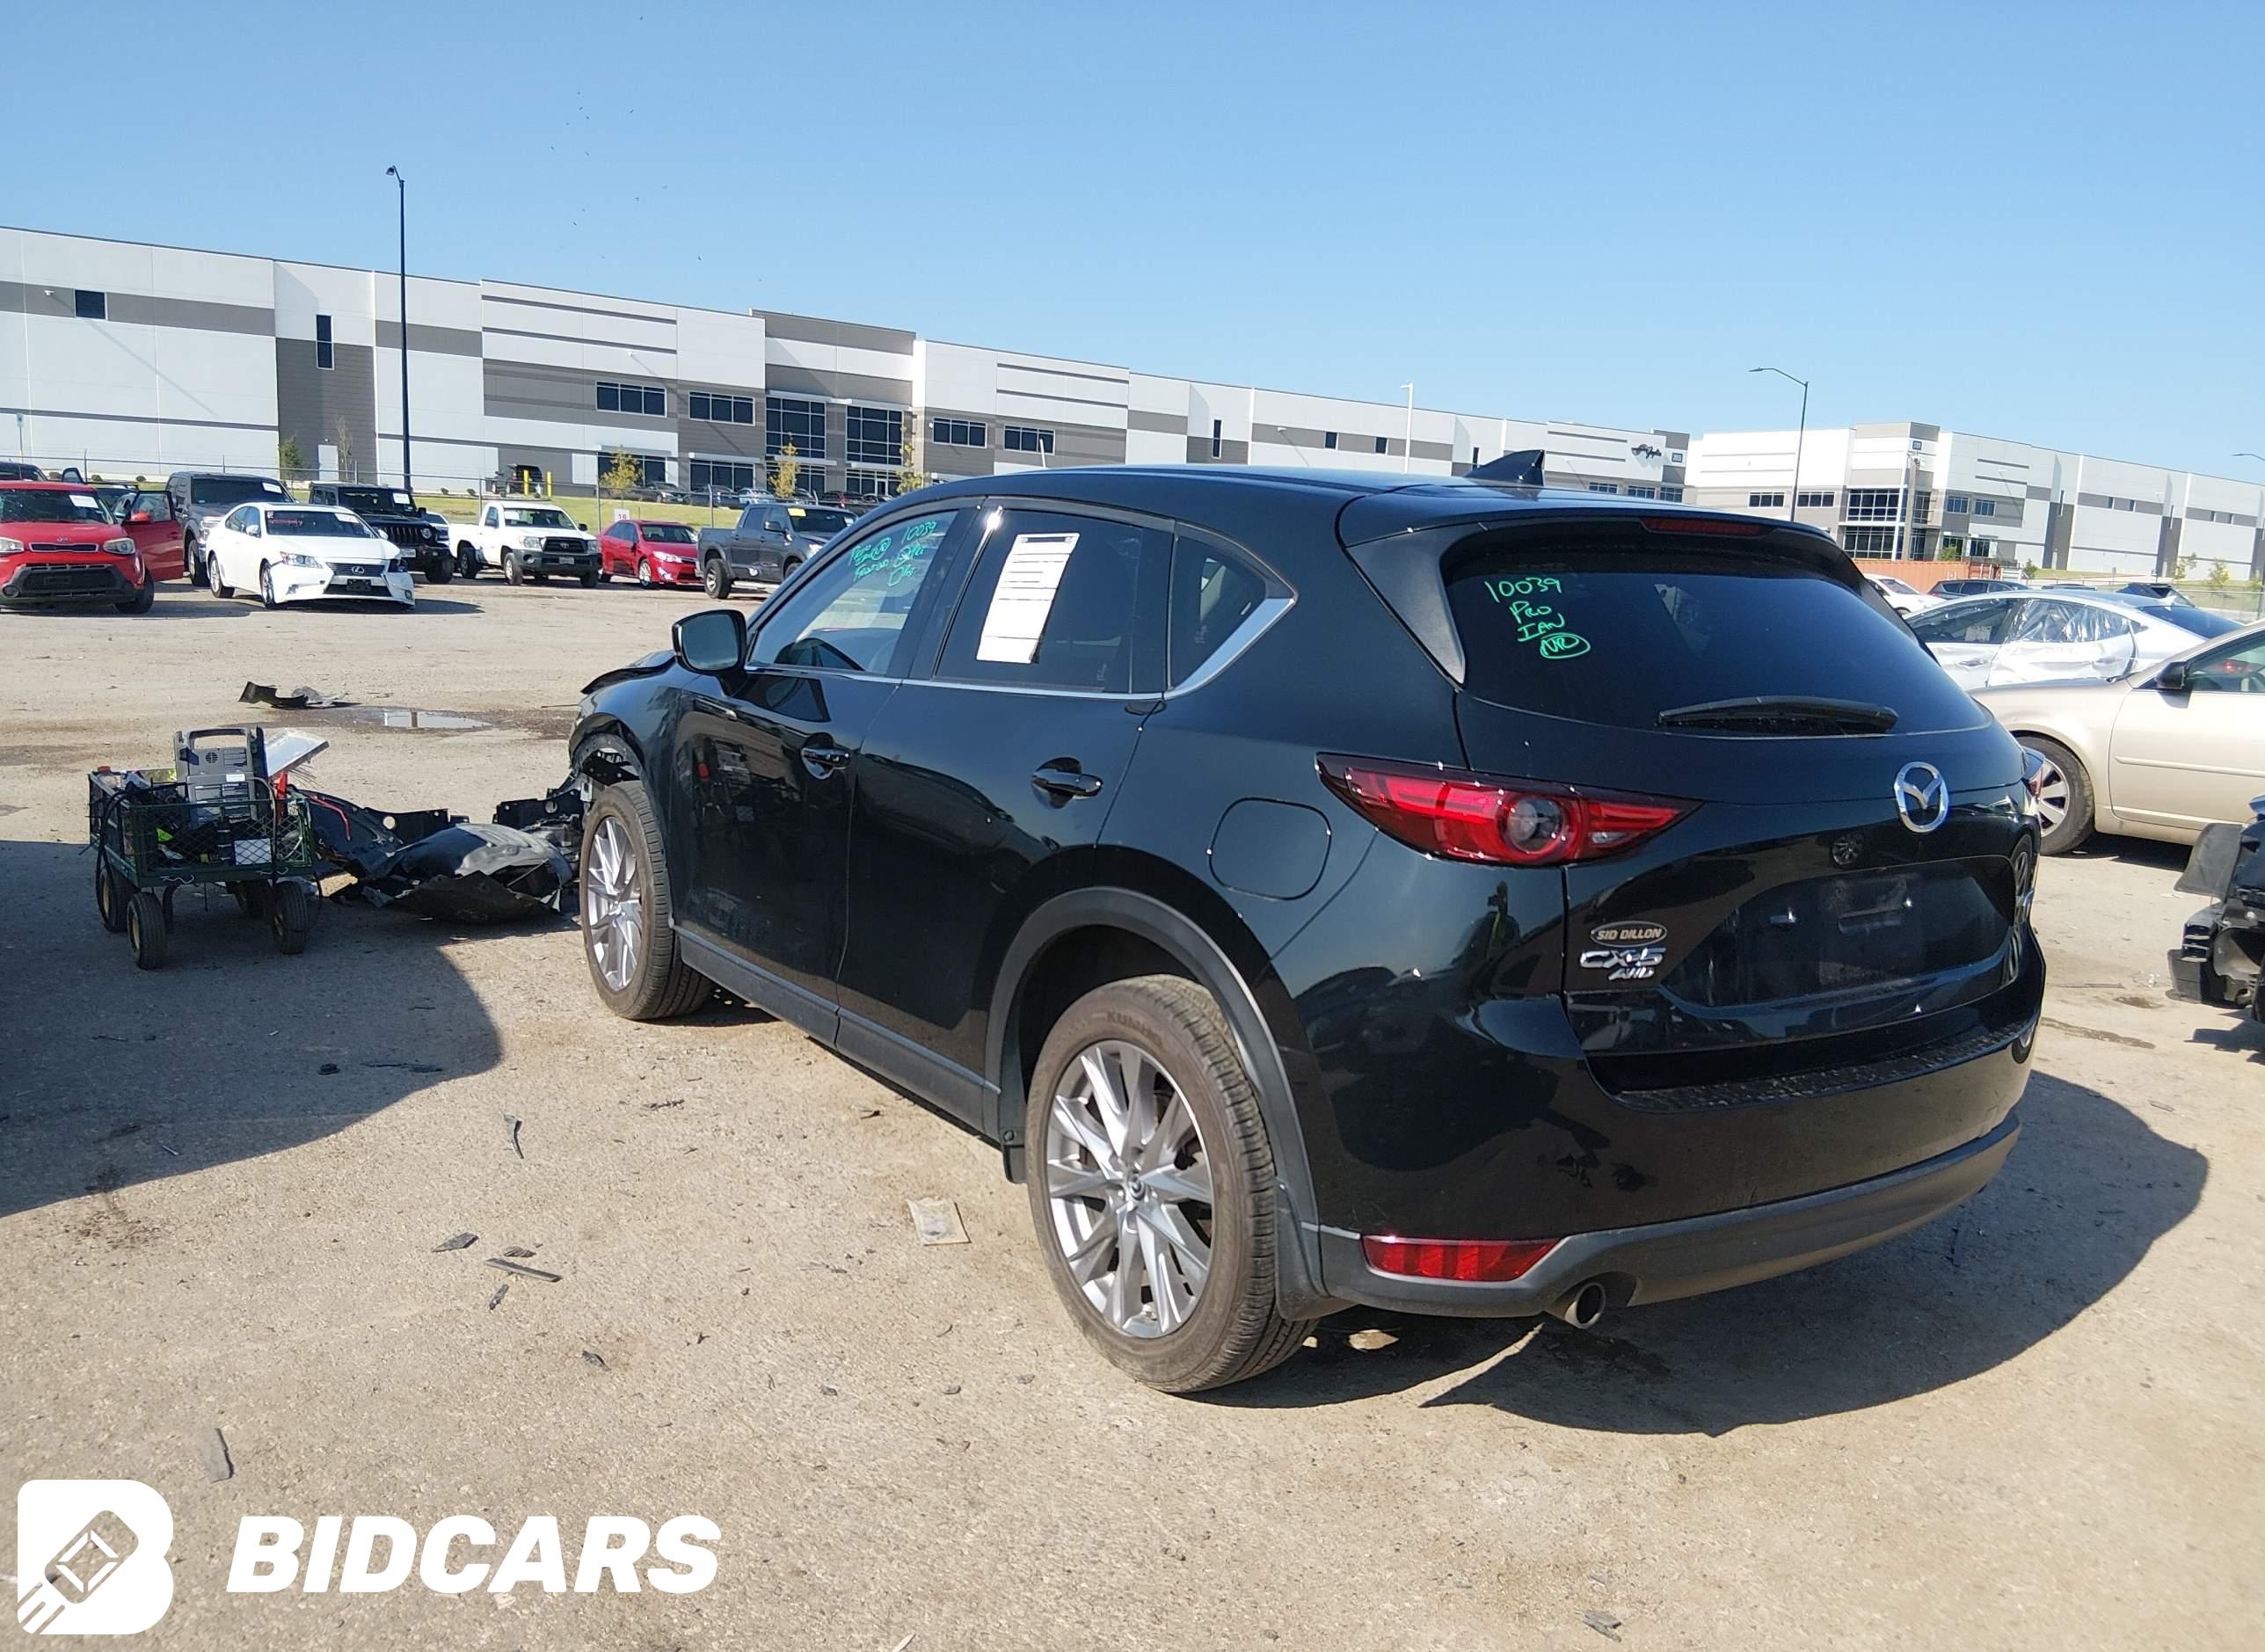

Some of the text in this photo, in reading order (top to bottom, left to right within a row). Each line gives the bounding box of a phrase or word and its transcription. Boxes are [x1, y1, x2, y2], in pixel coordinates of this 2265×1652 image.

[1484, 577, 1562, 603] 10039
[1597, 928, 1663, 941] SID DILLON
[1580, 948, 1666, 969] CX-5
